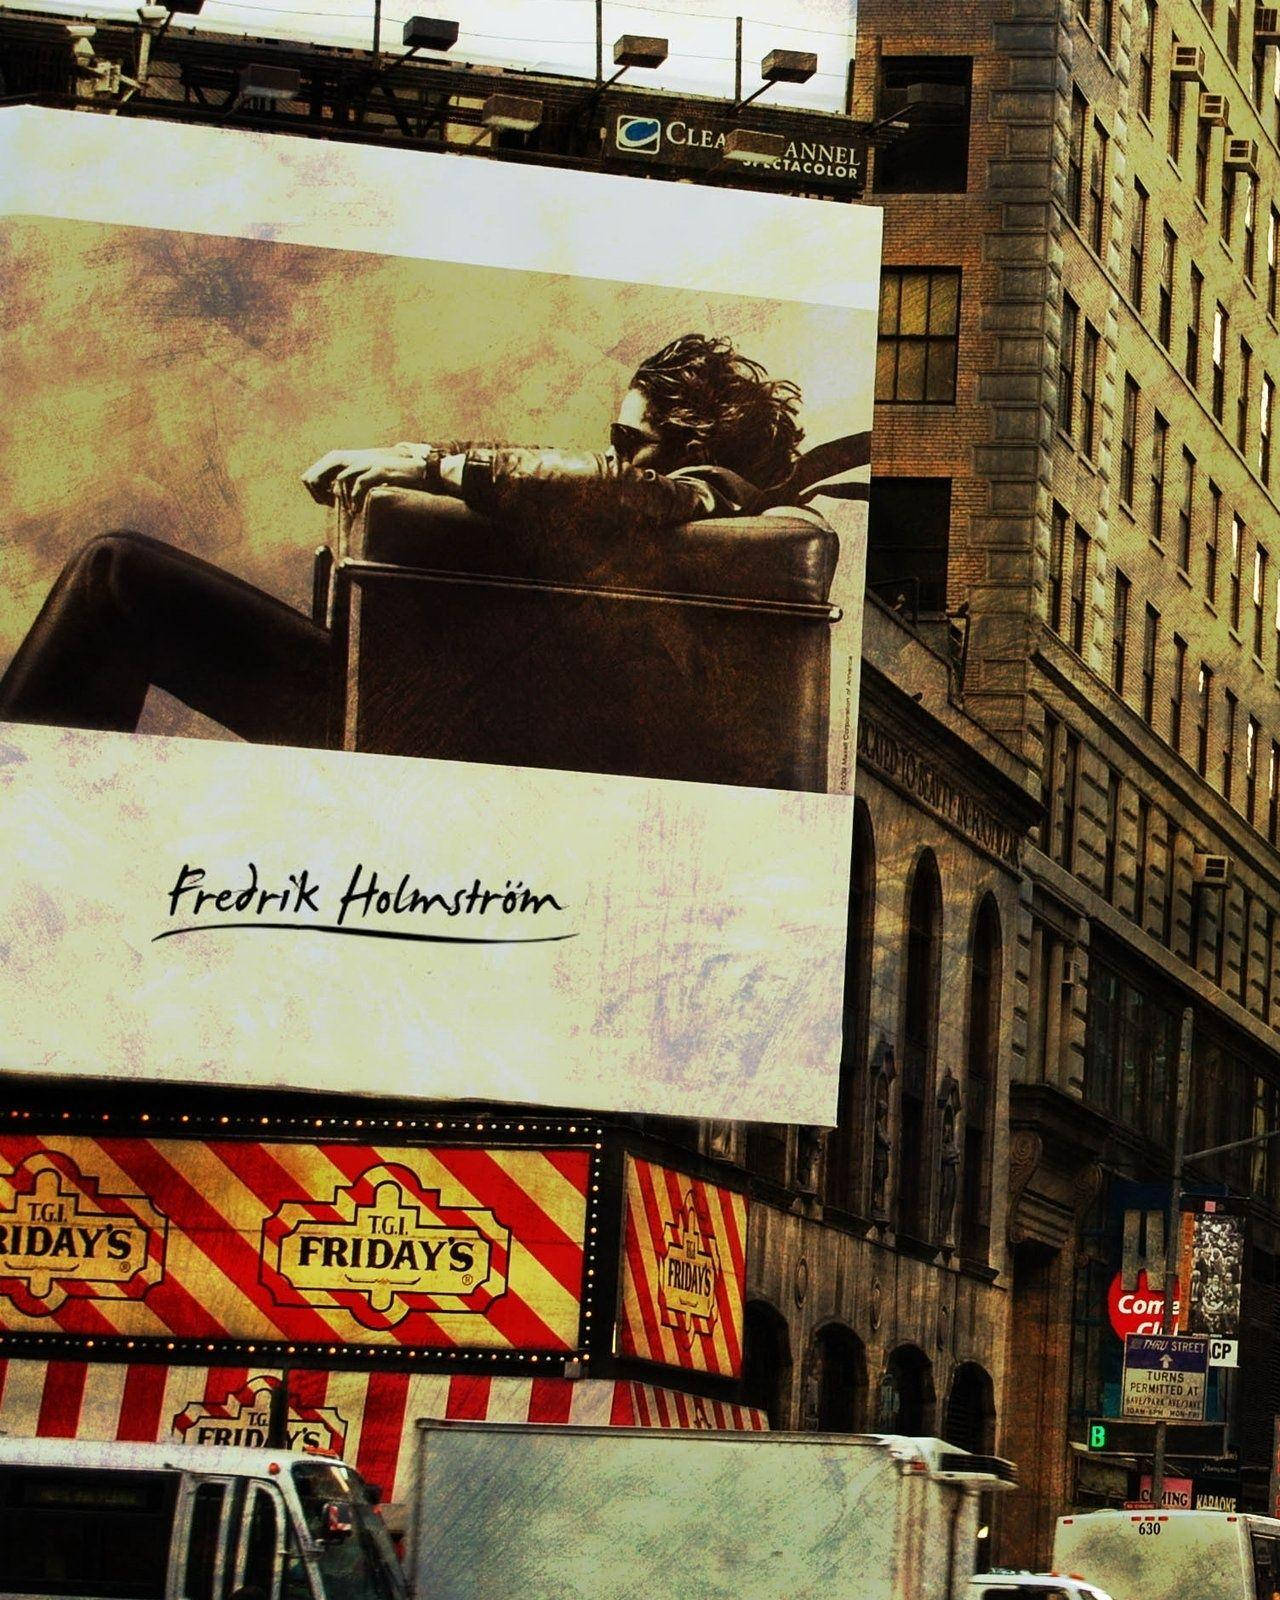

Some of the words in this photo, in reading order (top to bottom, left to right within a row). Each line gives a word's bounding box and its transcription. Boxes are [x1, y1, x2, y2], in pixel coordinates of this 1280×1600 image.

[666, 121, 727, 149] CLEA
[784, 141, 860, 167] ANNEL
[168, 862, 320, 916] Fredrik
[336, 863, 564, 926] Holmström
[28, 1202, 67, 1223] T.G.I.
[367, 1214, 409, 1236] T.G.I.
[298, 1235, 475, 1273] FRIDAY'S
[668, 1258, 712, 1298] FRIDAY'S
[1143, 1339, 1168, 1351] THRU
[1171, 1340, 1206, 1354] STREET
[1147, 1370, 1185, 1384] TURNS
[1130, 1382, 1184, 1396] PERMITTED
[1187, 1386, 1199, 1397] AT
[248, 1411, 270, 1427] T.G.
[198, 1426, 321, 1451] FRIDY'S
[1091, 1424, 1106, 1448] B
[1138, 1522, 1161, 1536] 630
